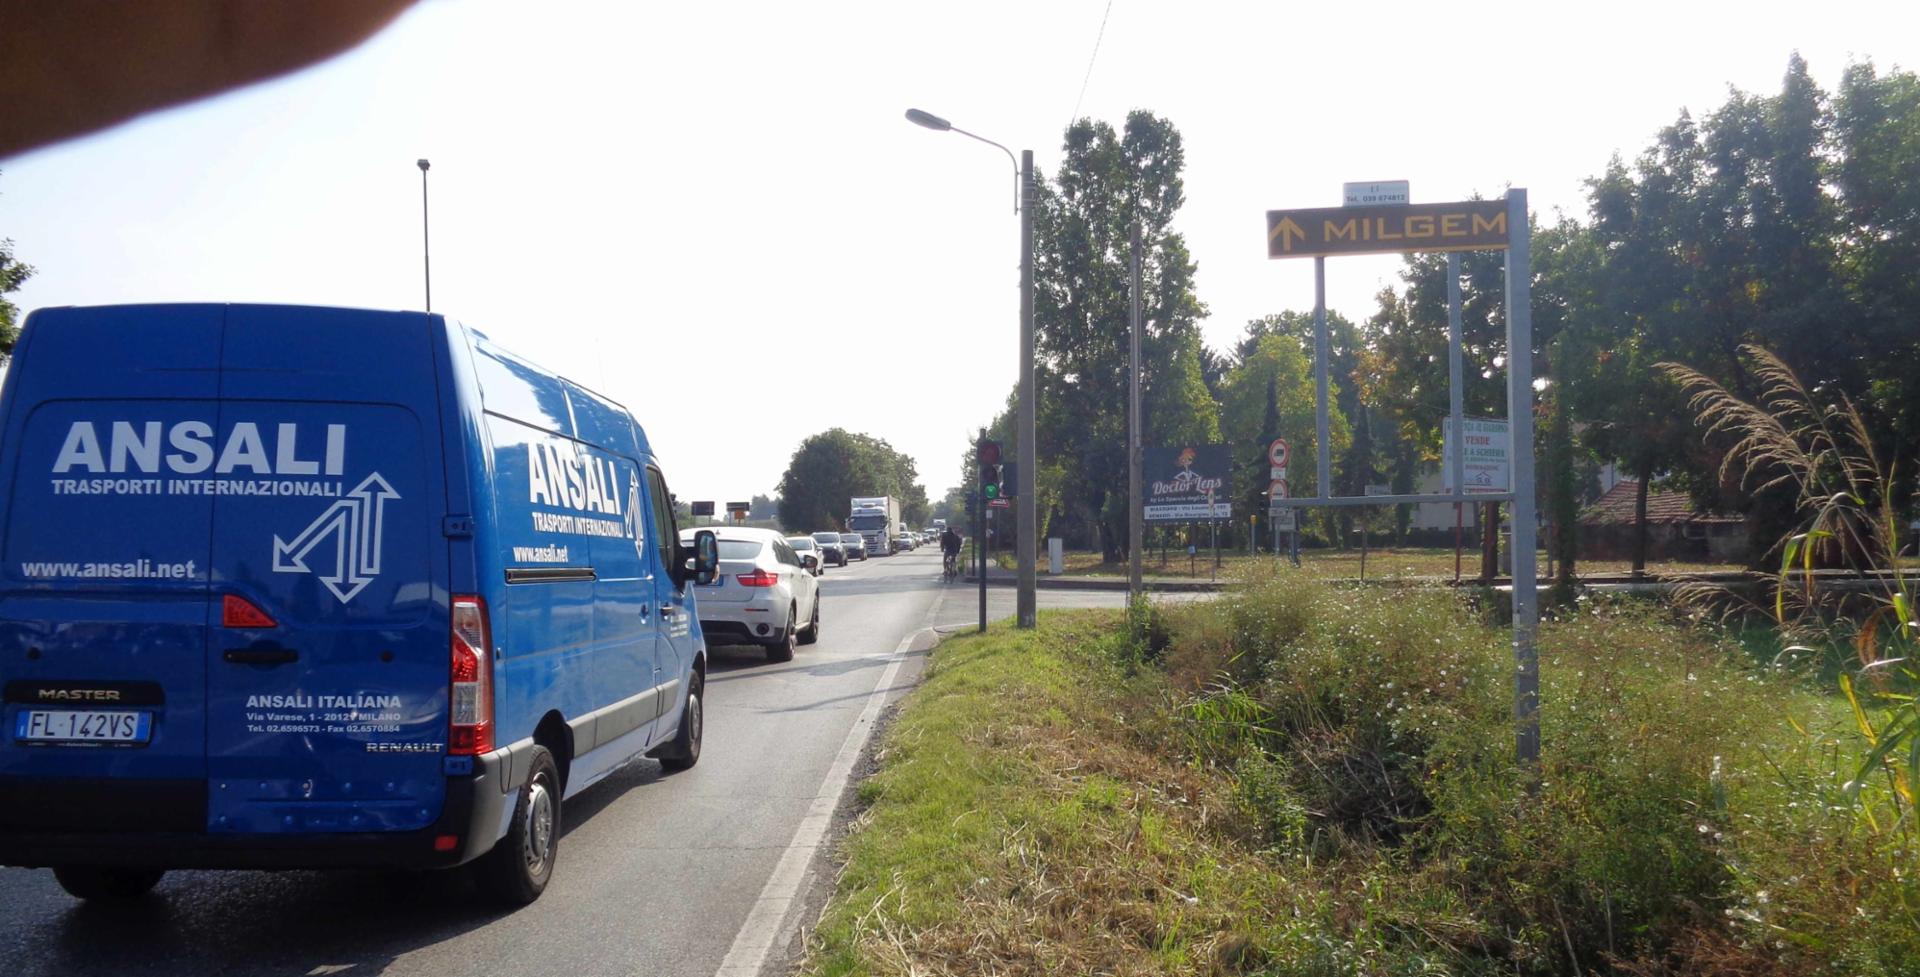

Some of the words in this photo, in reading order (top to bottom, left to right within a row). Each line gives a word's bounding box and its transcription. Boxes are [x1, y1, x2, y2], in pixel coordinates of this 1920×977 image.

[1324, 211, 1506, 243] MILGEM
[51, 420, 347, 476] ANSALI
[527, 441, 622, 515] ANSALI
[1152, 480, 1193, 495] Doctor
[1194, 476, 1222, 494] Lens
[52, 479, 162, 495] TRASPORTI
[168, 479, 343, 497] INTERNAZIONALI
[532, 512, 575, 535] TRASPORTI
[575, 517, 624, 539] INTERNAZIONALI
[513, 543, 568, 563] www.ansali.net
[22, 559, 195, 579] www.ansali.net
[38, 689, 121, 700] MASTER
[246, 695, 312, 708] ANSALI
[318, 695, 402, 708] ITALIANA
[30, 712, 55, 737] FL
[69, 713, 136, 738] 142VS
[246, 712, 264, 721] Via
[266, 712, 306, 722] Varese,
[309, 713, 315, 721] 1
[358, 712, 401, 721] MILANO
[247, 724, 264, 732] Tel.
[327, 725, 344, 733] Fax
[366, 742, 444, 753] RENAULT
